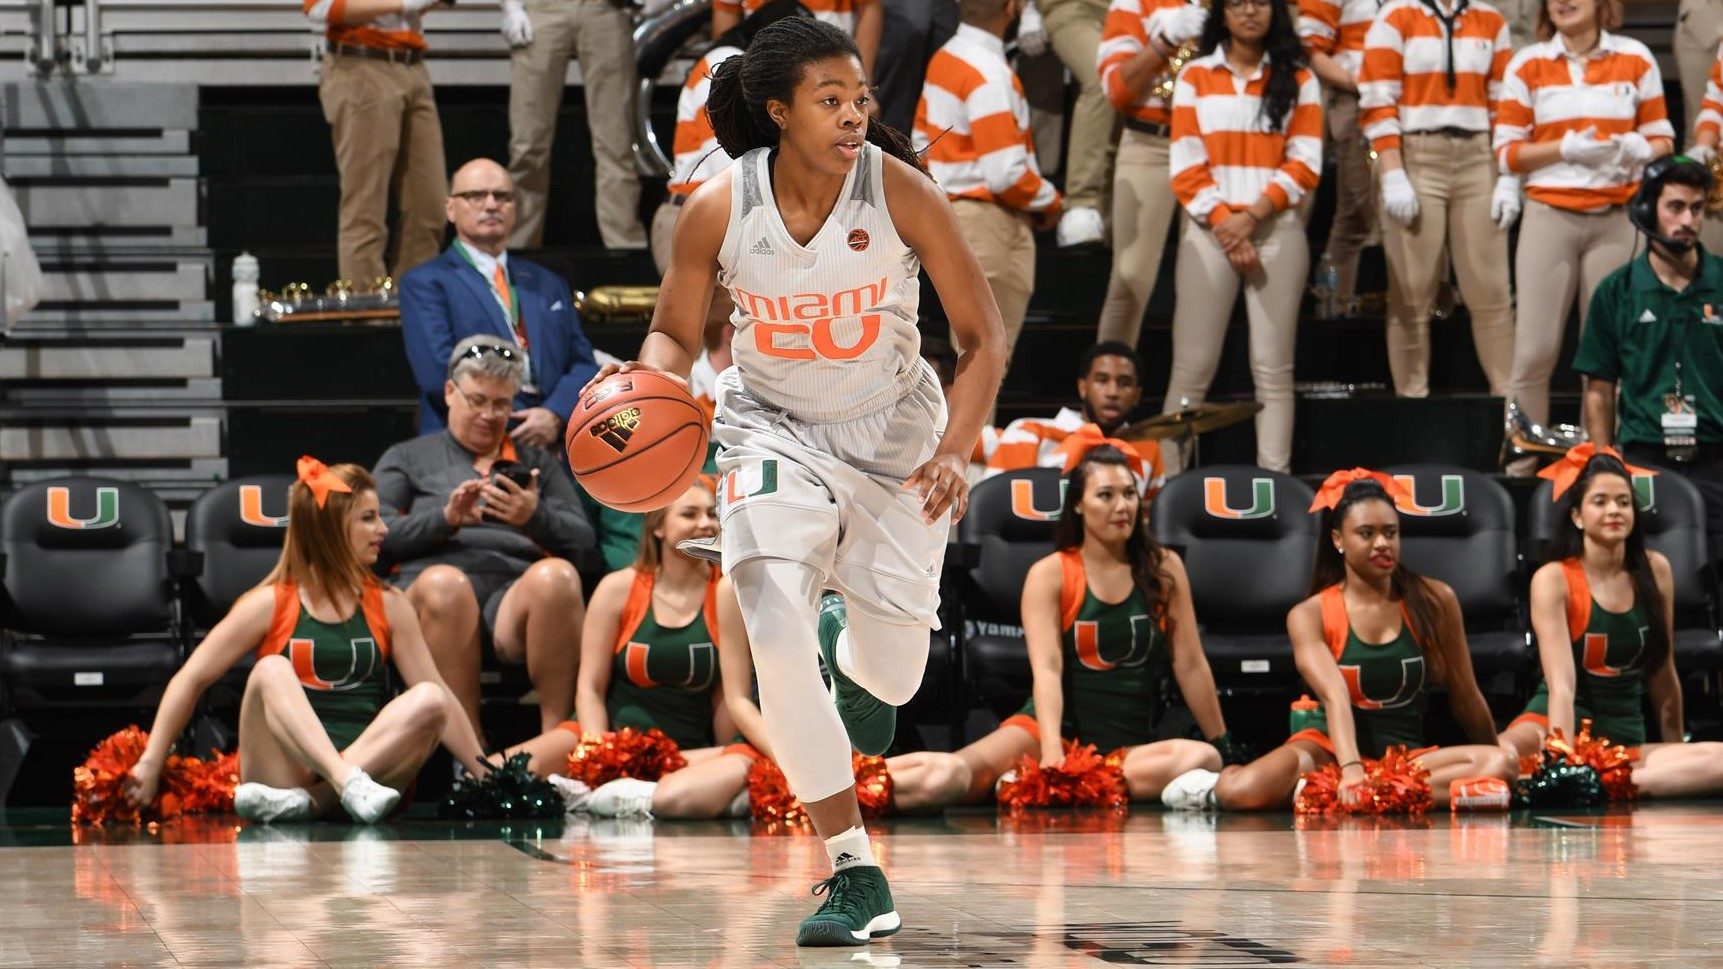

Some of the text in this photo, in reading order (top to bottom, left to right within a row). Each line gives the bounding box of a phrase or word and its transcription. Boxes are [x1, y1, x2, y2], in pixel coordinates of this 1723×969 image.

[589, 407, 641, 437] adidas
[727, 458, 779, 505] U
[1010, 479, 1069, 520] U
[1204, 477, 1274, 519] U
[1395, 475, 1464, 516] U
[47, 486, 119, 529] U
[289, 637, 375, 691] U
[1074, 614, 1154, 670] U
[625, 641, 715, 692] U
[1338, 656, 1425, 709] U
